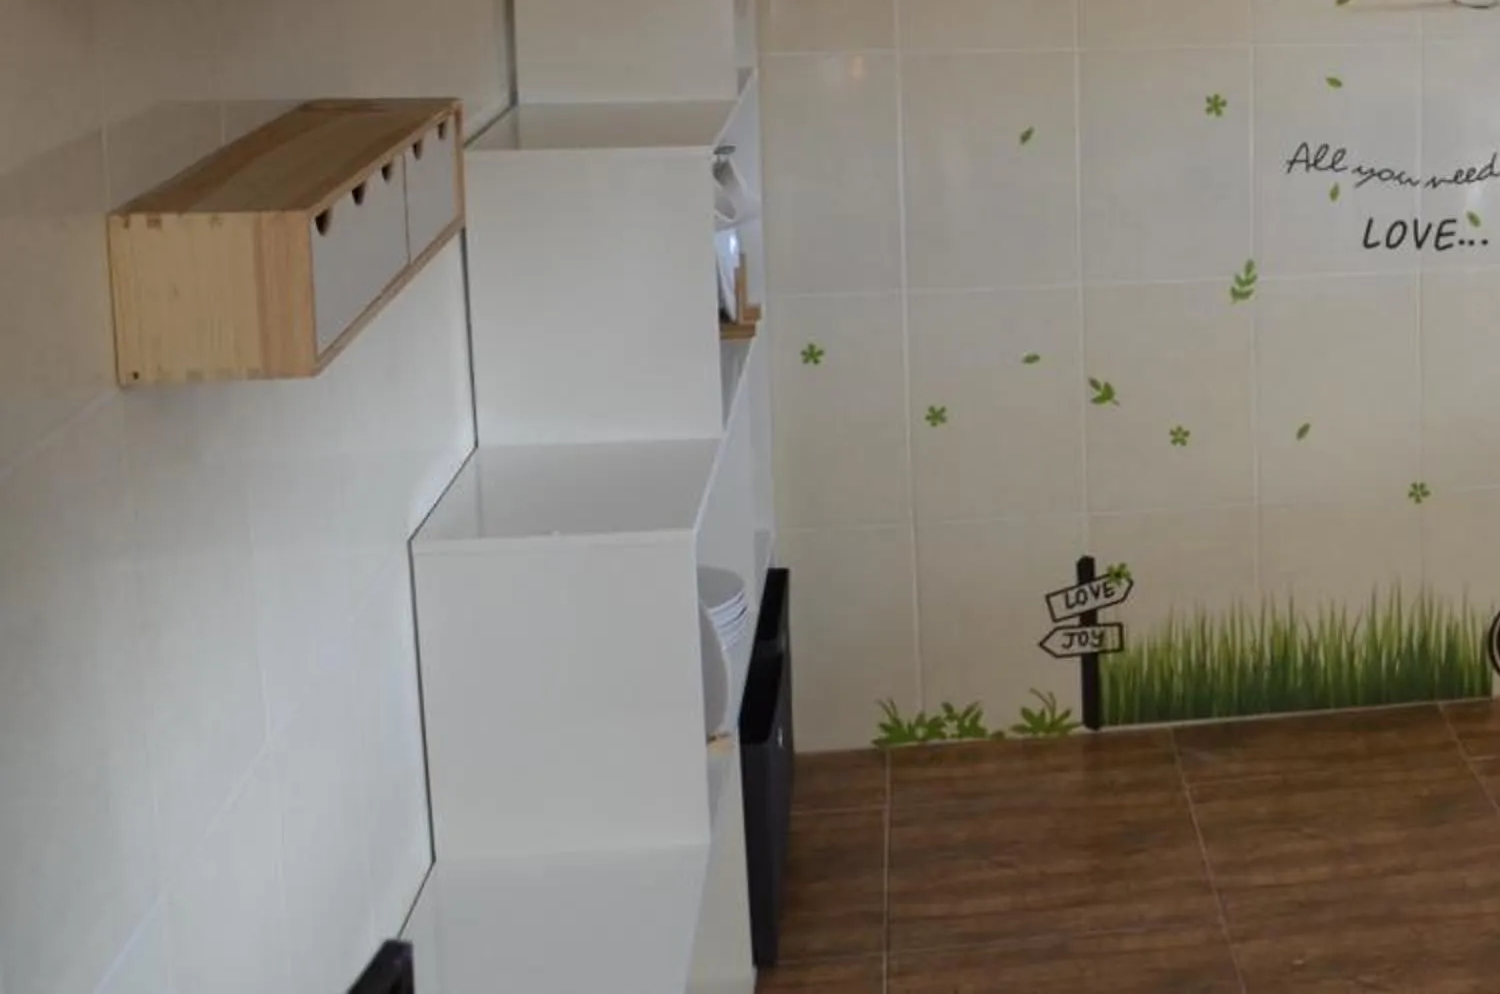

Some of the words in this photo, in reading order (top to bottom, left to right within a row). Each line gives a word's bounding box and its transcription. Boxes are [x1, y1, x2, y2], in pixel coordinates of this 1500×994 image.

[1286, 142, 1349, 174] All
[1352, 164, 1420, 189] you
[1065, 581, 1116, 609] LOVE
[1061, 628, 1105, 649] JOY
